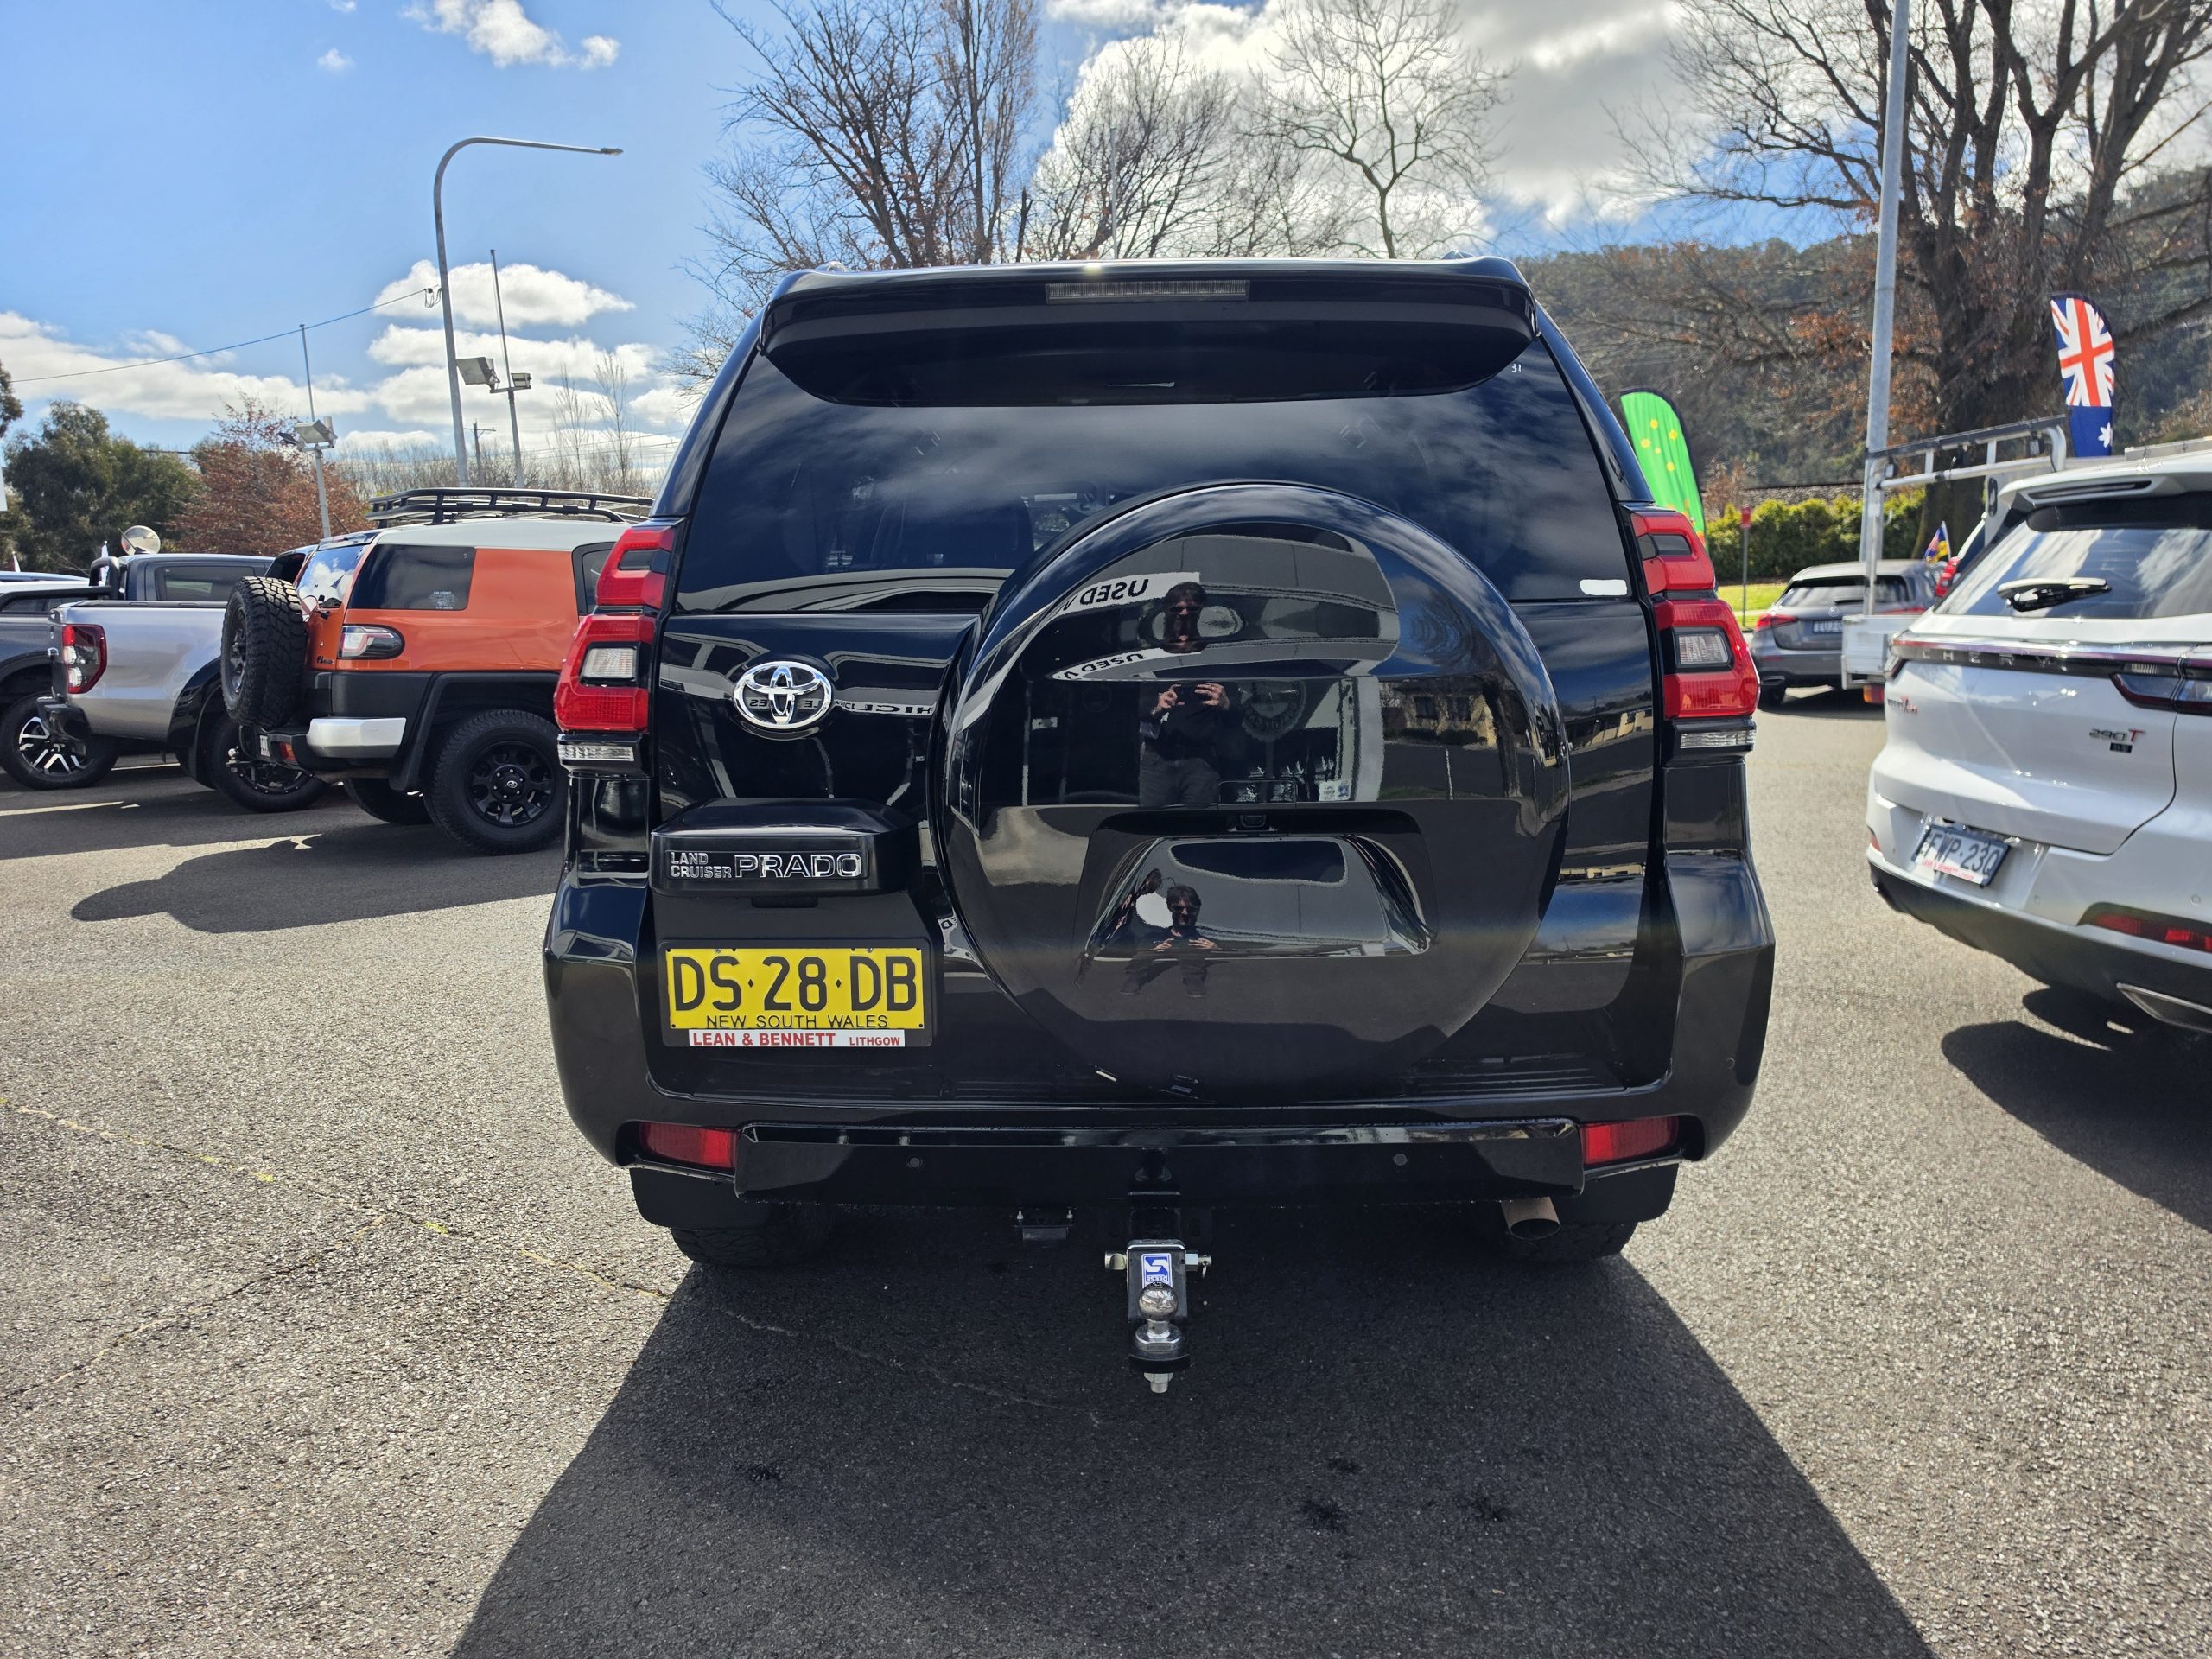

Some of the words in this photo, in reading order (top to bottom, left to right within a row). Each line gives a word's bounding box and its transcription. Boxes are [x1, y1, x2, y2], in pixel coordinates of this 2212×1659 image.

[671, 852, 709, 865] LAND
[671, 865, 732, 879] CRUISER
[734, 854, 862, 878] PRADO
[706, 1014, 747, 1028] NEW
[756, 1014, 817, 1028] SOUTH
[828, 1014, 888, 1028] WALES
[692, 1033, 736, 1046] LEAN
[741, 1033, 753, 1046] &
[759, 1033, 836, 1046] BENNETT
[849, 1036, 900, 1046] LITHGOW
